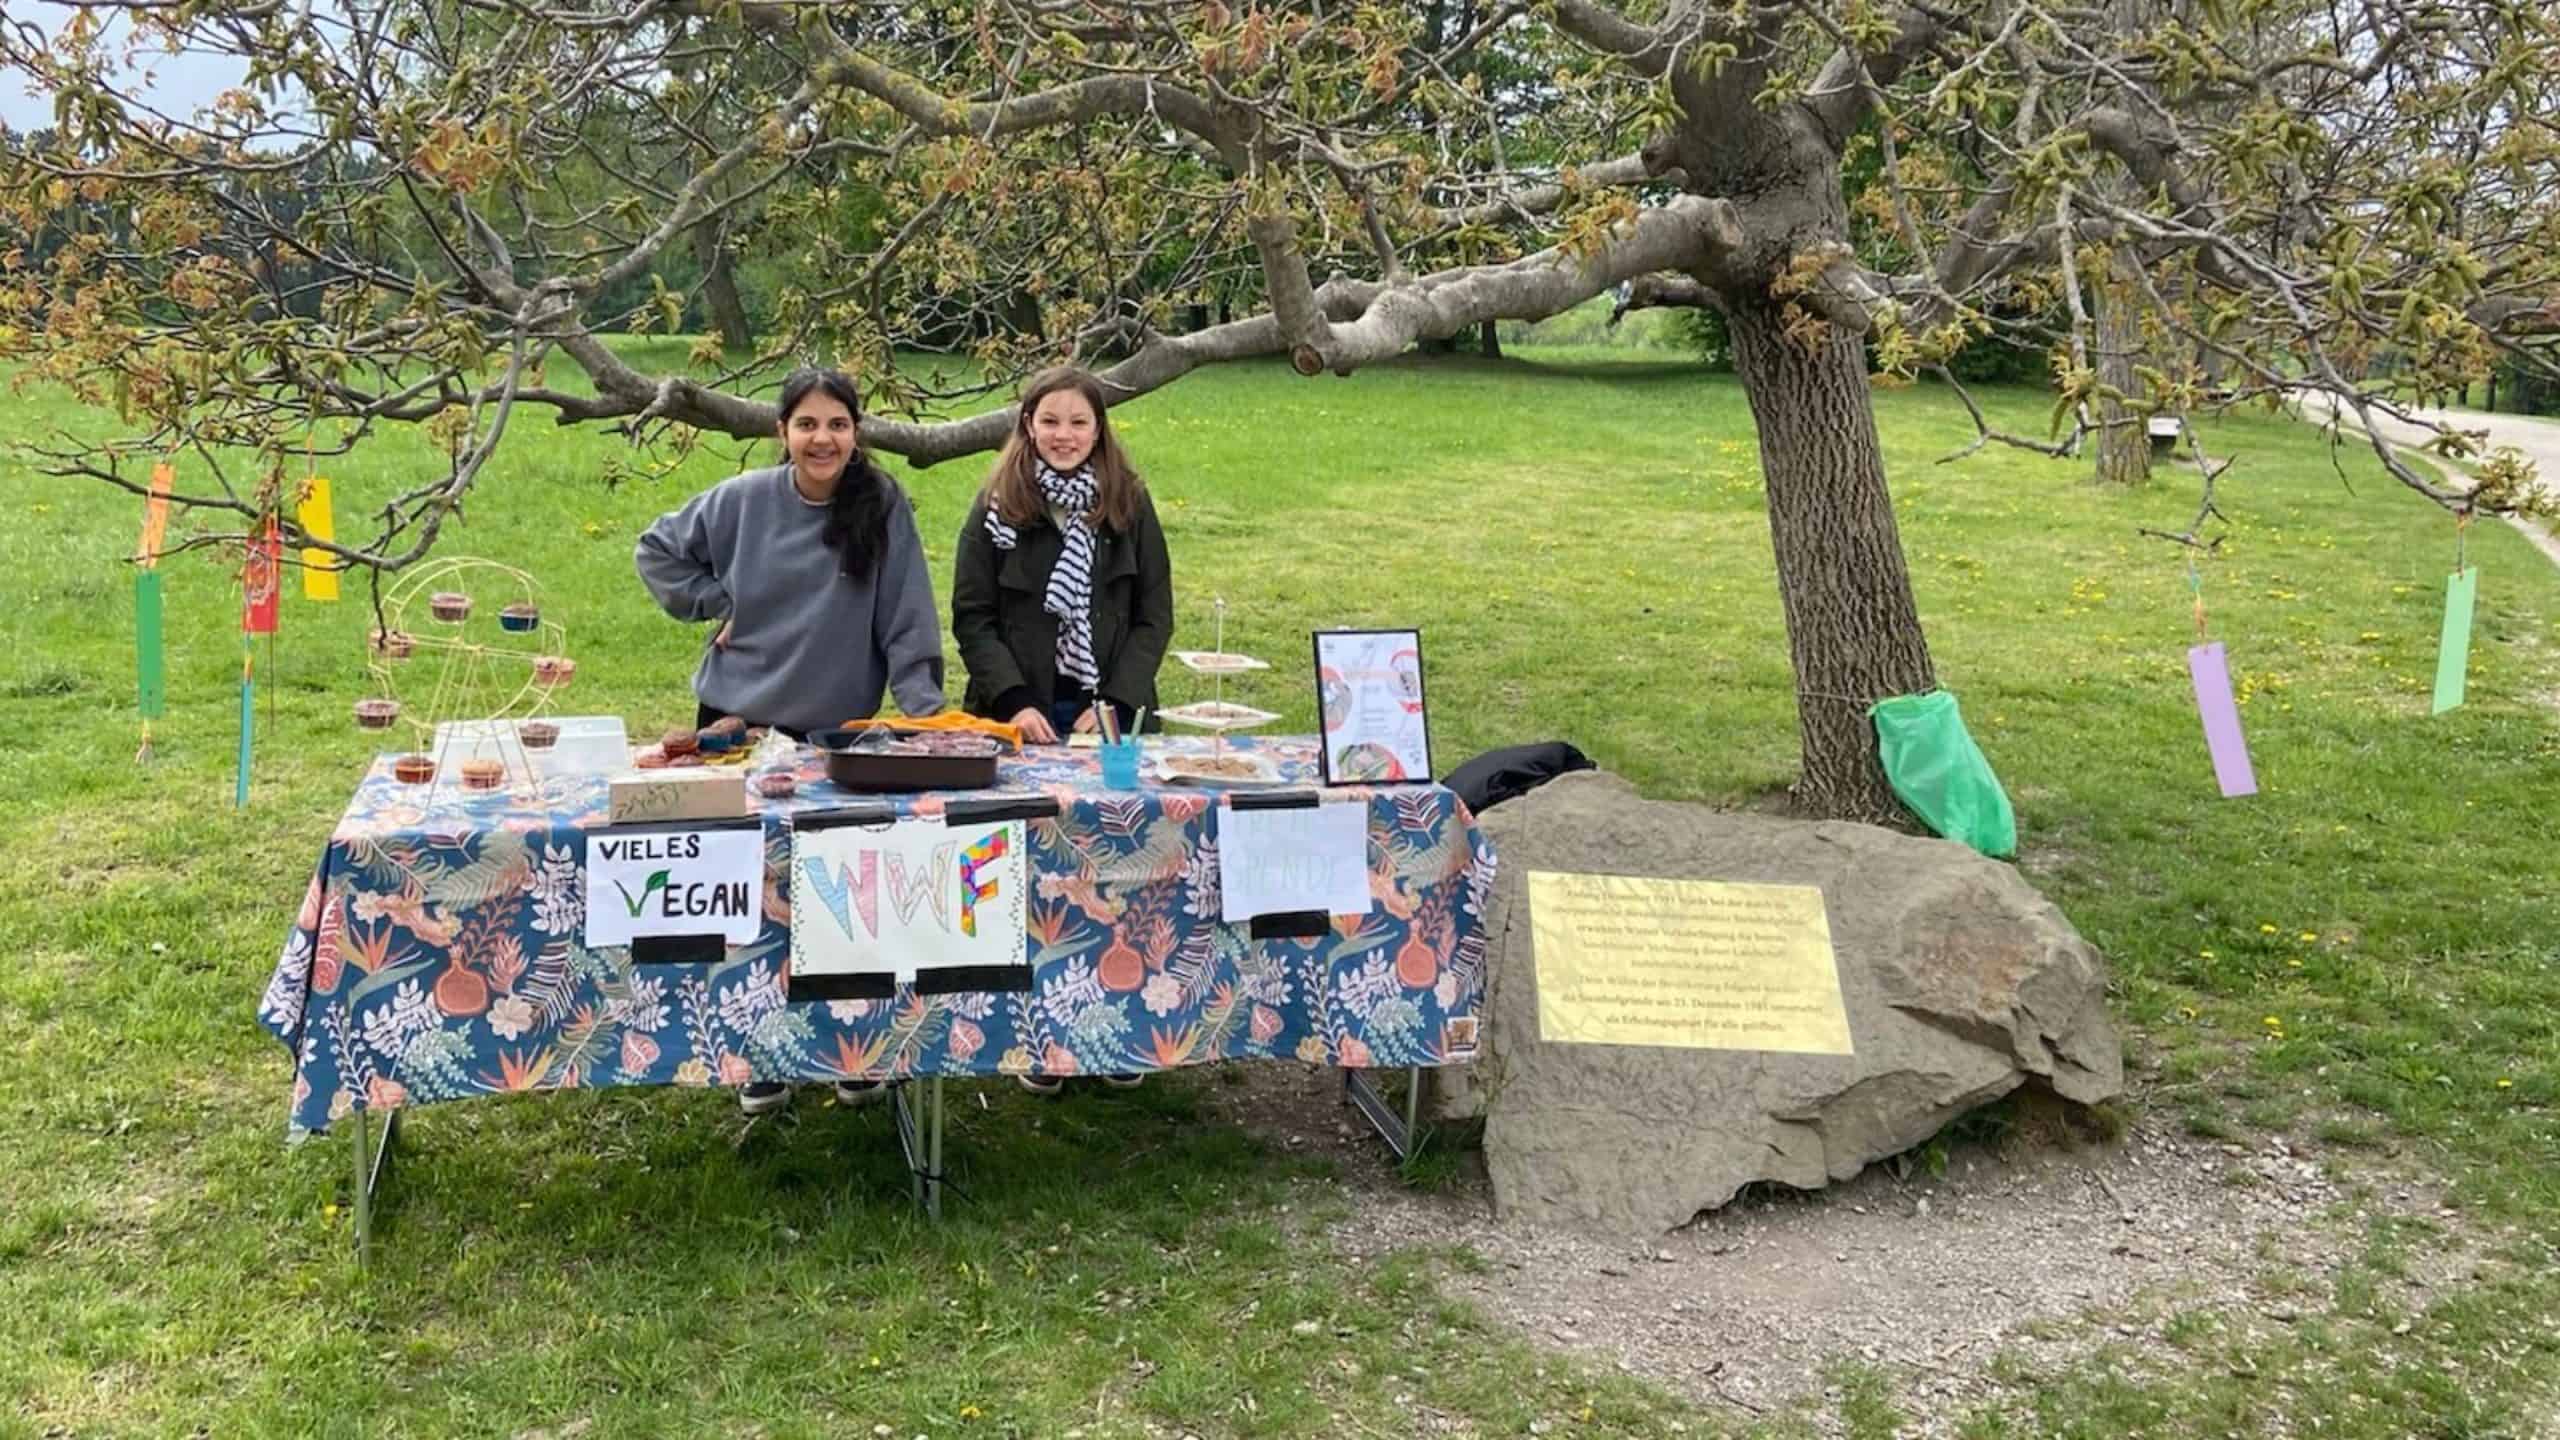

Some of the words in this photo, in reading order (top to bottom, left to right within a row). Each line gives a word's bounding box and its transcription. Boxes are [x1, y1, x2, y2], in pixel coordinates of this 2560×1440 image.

[599, 834, 701, 861] VIELES
[613, 869, 749, 918] VEGAN
[803, 827, 1010, 942] WWF
